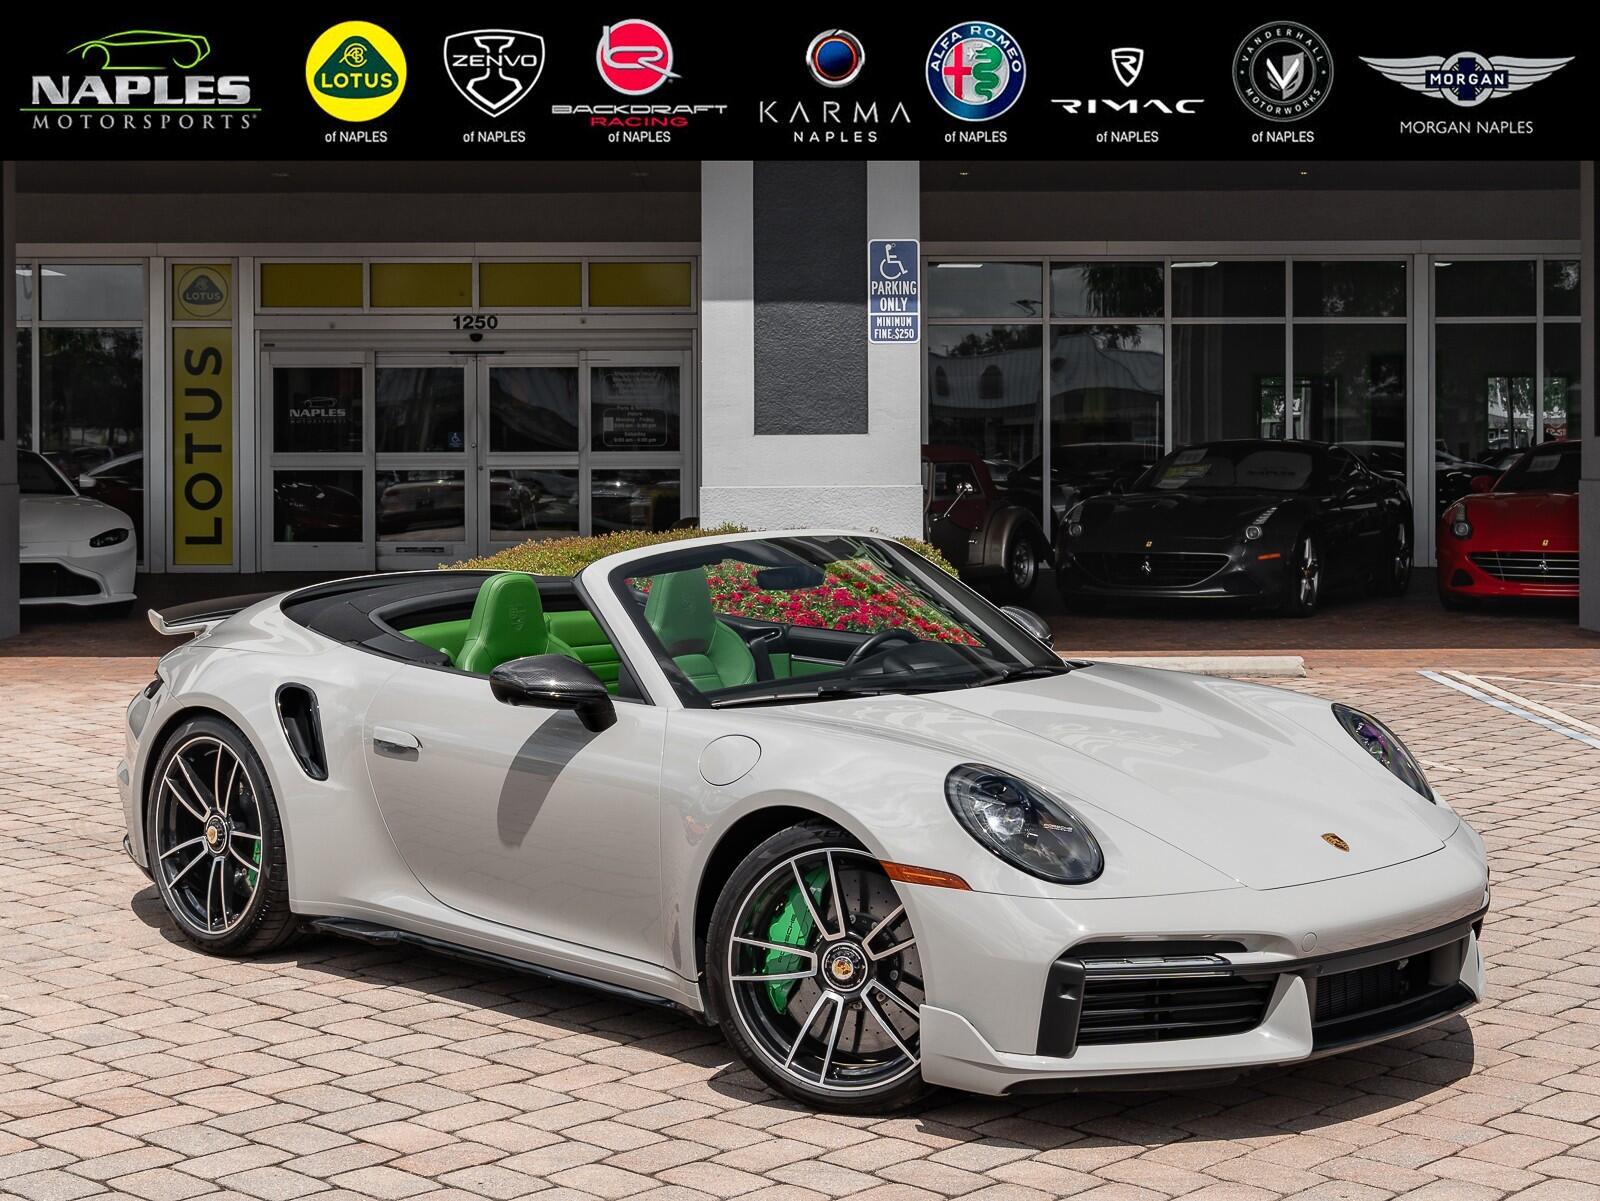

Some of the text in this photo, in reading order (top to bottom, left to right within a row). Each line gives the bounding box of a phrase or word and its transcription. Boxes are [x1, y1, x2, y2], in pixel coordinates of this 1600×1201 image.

[871, 280, 917, 295] PARKING
[186, 291, 221, 301] LOTUS
[879, 296, 908, 312] ONLY
[453, 314, 498, 330] 1250
[876, 316, 912, 327] MINIMUM
[874, 327, 915, 340] FINE $250
[289, 408, 346, 417] NAPLES
[184, 346, 223, 545] LOTUS
